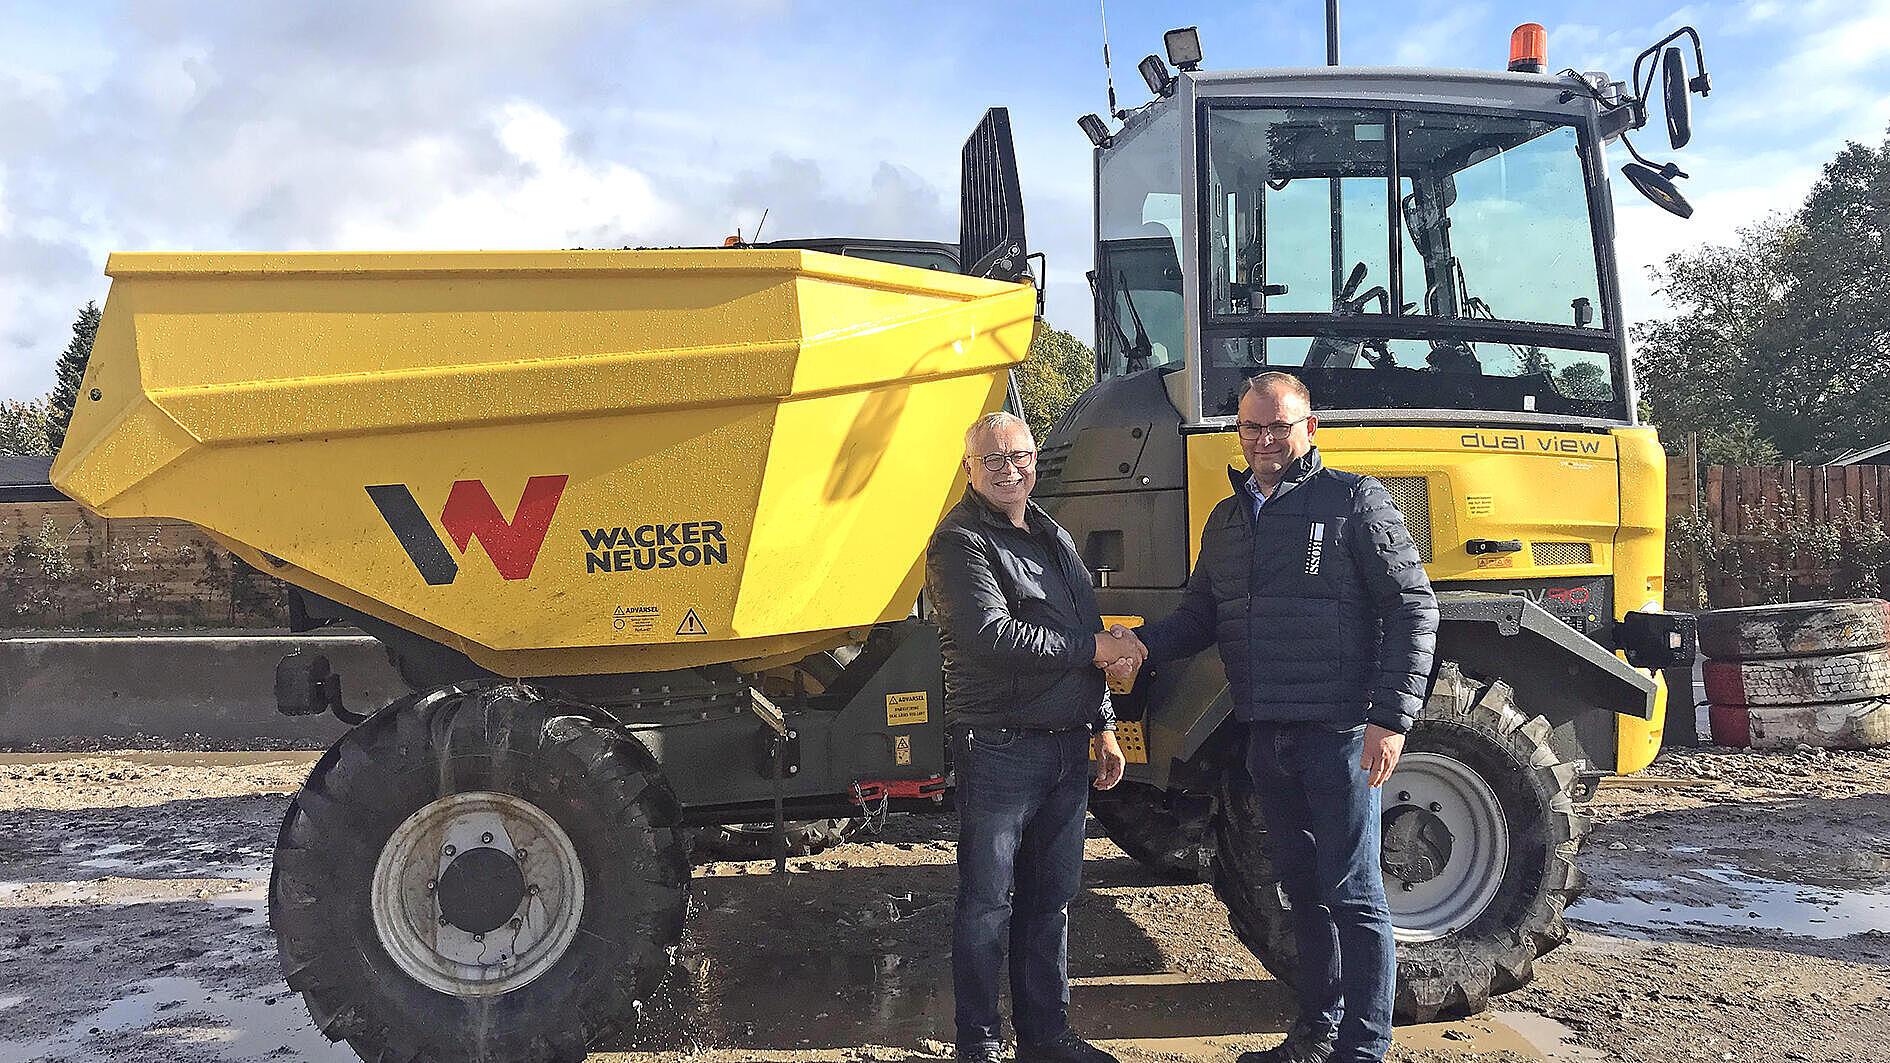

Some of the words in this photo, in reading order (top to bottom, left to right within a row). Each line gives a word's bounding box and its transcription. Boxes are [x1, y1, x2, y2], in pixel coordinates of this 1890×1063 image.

[1461, 433, 1525, 450] dual
[1537, 436, 1600, 454] view
[580, 520, 727, 550] WACKER
[585, 543, 728, 573] NEUSON
